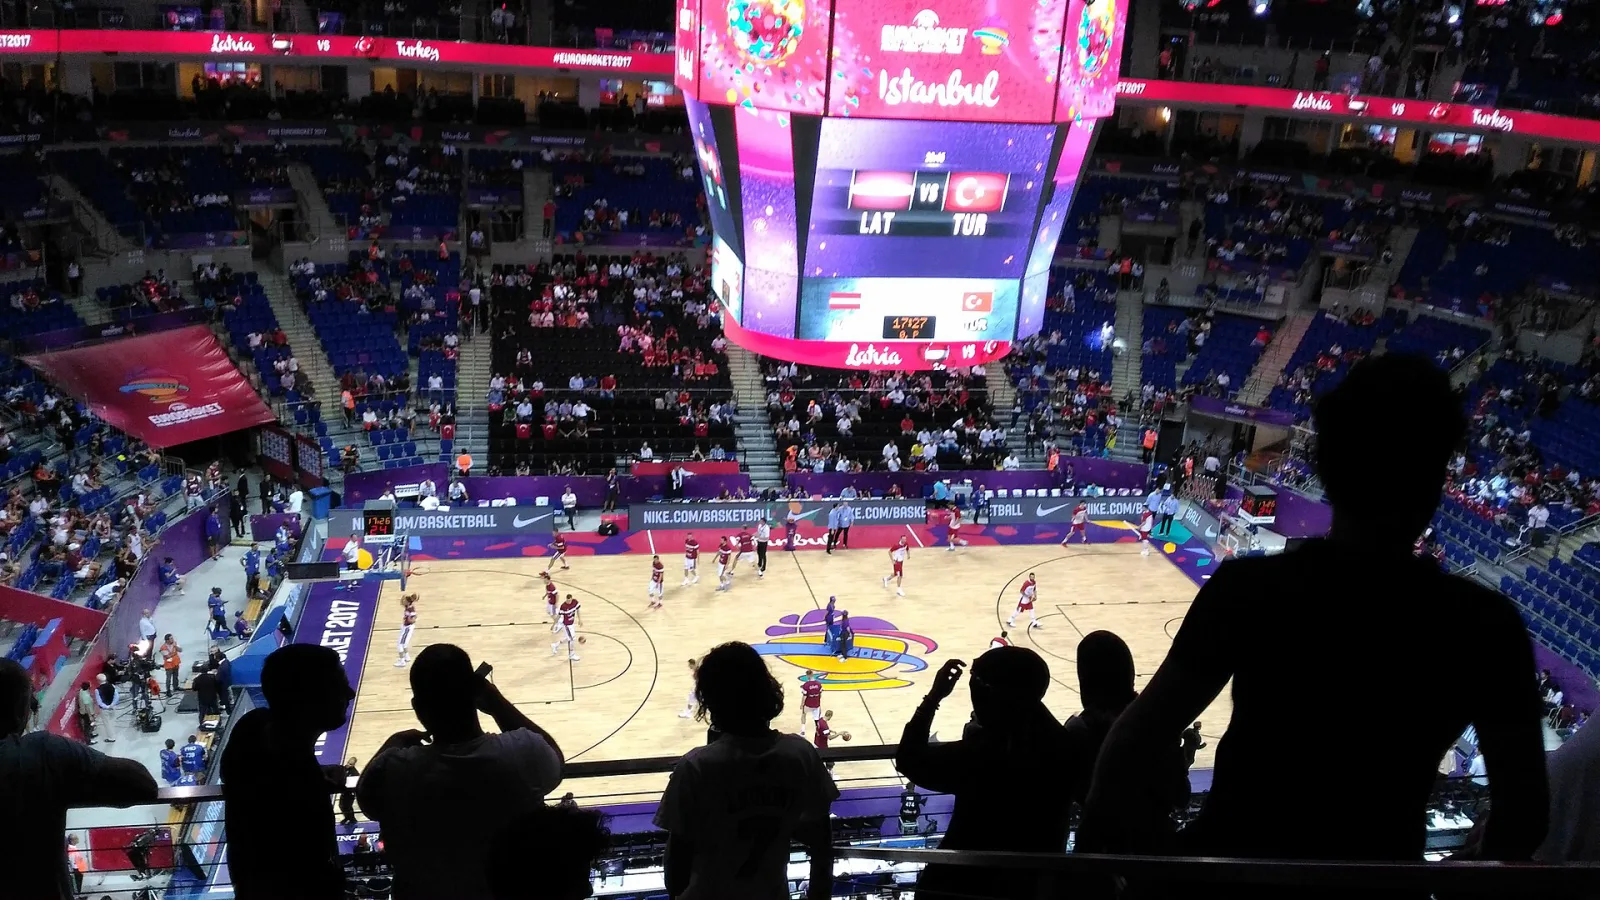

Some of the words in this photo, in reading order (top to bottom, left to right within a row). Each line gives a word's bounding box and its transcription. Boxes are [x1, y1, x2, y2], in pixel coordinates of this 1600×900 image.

[210, 34, 255, 53] Latvia
[317, 39, 331, 52] VS
[395, 40, 440, 61] Turkey
[553, 52, 632, 68] #EUROBASKET2017
[879, 67, 1000, 108] Istanbul
[1292, 92, 1333, 111] Latvia
[1391, 102, 1406, 116] VS
[1472, 108, 1514, 132] Turkey
[920, 182, 940, 203] VS
[859, 211, 896, 234] LAT
[953, 212, 988, 236] TUR
[892, 316, 928, 329] 17:27
[845, 343, 902, 366] Latvia
[962, 344, 976, 359] VS
[370, 525, 388, 536] 24
[325, 599, 361, 629] 2017
